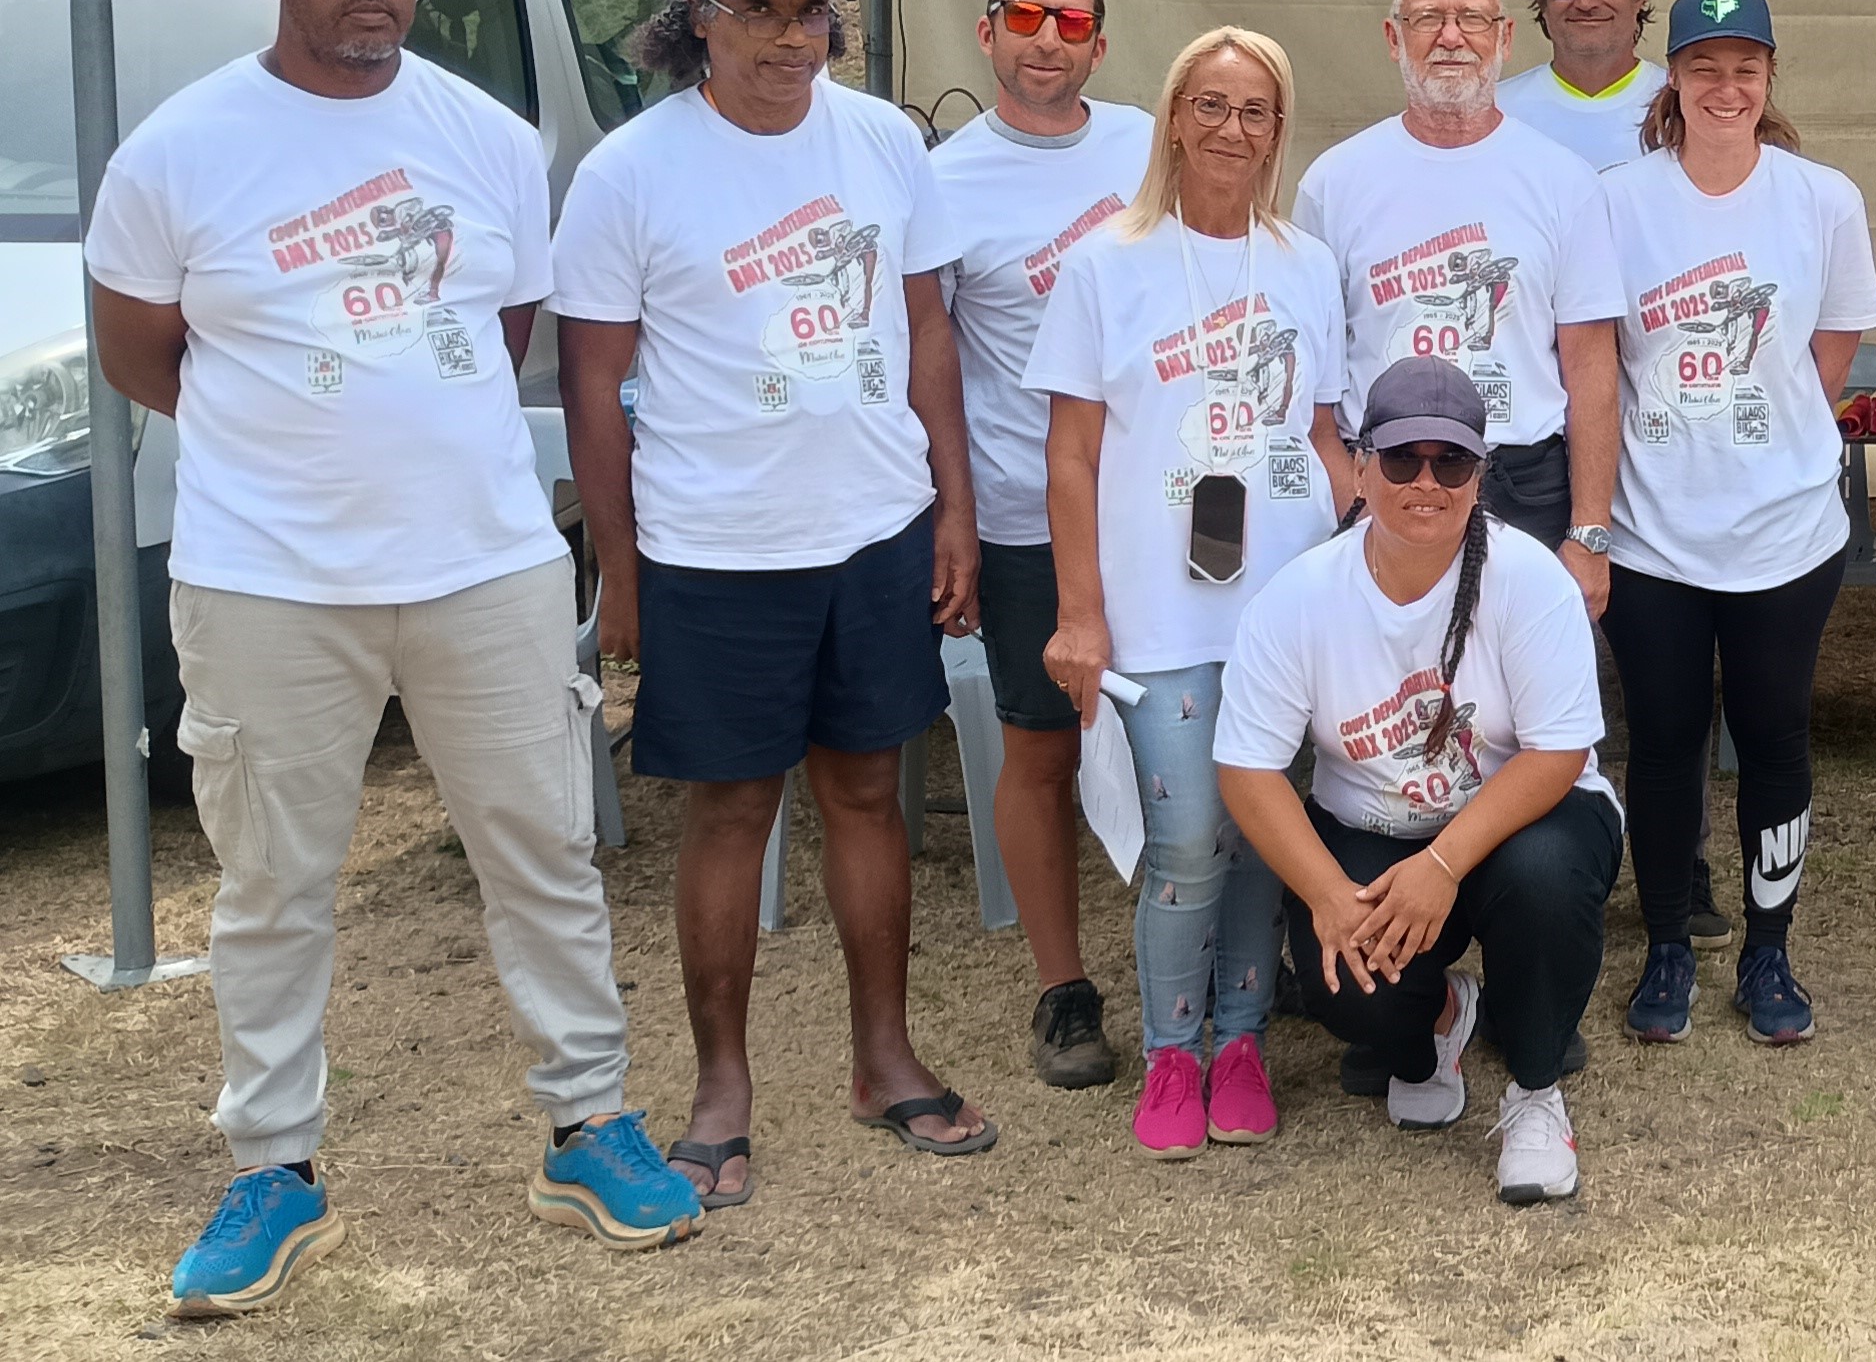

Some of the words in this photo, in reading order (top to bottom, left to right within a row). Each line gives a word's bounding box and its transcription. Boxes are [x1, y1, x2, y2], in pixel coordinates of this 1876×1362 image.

[269, 214, 310, 243] COUPE
[272, 235, 324, 273] BMX
[322, 222, 375, 257] 2025
[724, 239, 757, 264] COUPE
[1025, 242, 1056, 270] COUPE
[727, 258, 770, 293] BMX
[769, 243, 813, 277] 2025
[1370, 255, 1401, 278] COUPE
[343, 282, 404, 316] 60
[1371, 275, 1405, 306] BMX
[1408, 265, 1447, 293] 2025
[1639, 287, 1663, 307] COUPE
[790, 304, 840, 339] 60
[1640, 305, 1669, 333] BMX
[1671, 292, 1709, 322] 2025
[1153, 330, 1186, 354] COUPE
[1413, 325, 1460, 356] 60
[1155, 349, 1196, 382] BMX
[1200, 337, 1237, 367] 025
[1678, 351, 1722, 381] 60
[1209, 401, 1254, 435] 60
[1340, 712, 1371, 736] COUPE
[1343, 733, 1383, 761] BMX
[1382, 711, 1418, 751] 2025
[1402, 772, 1450, 803] 60
